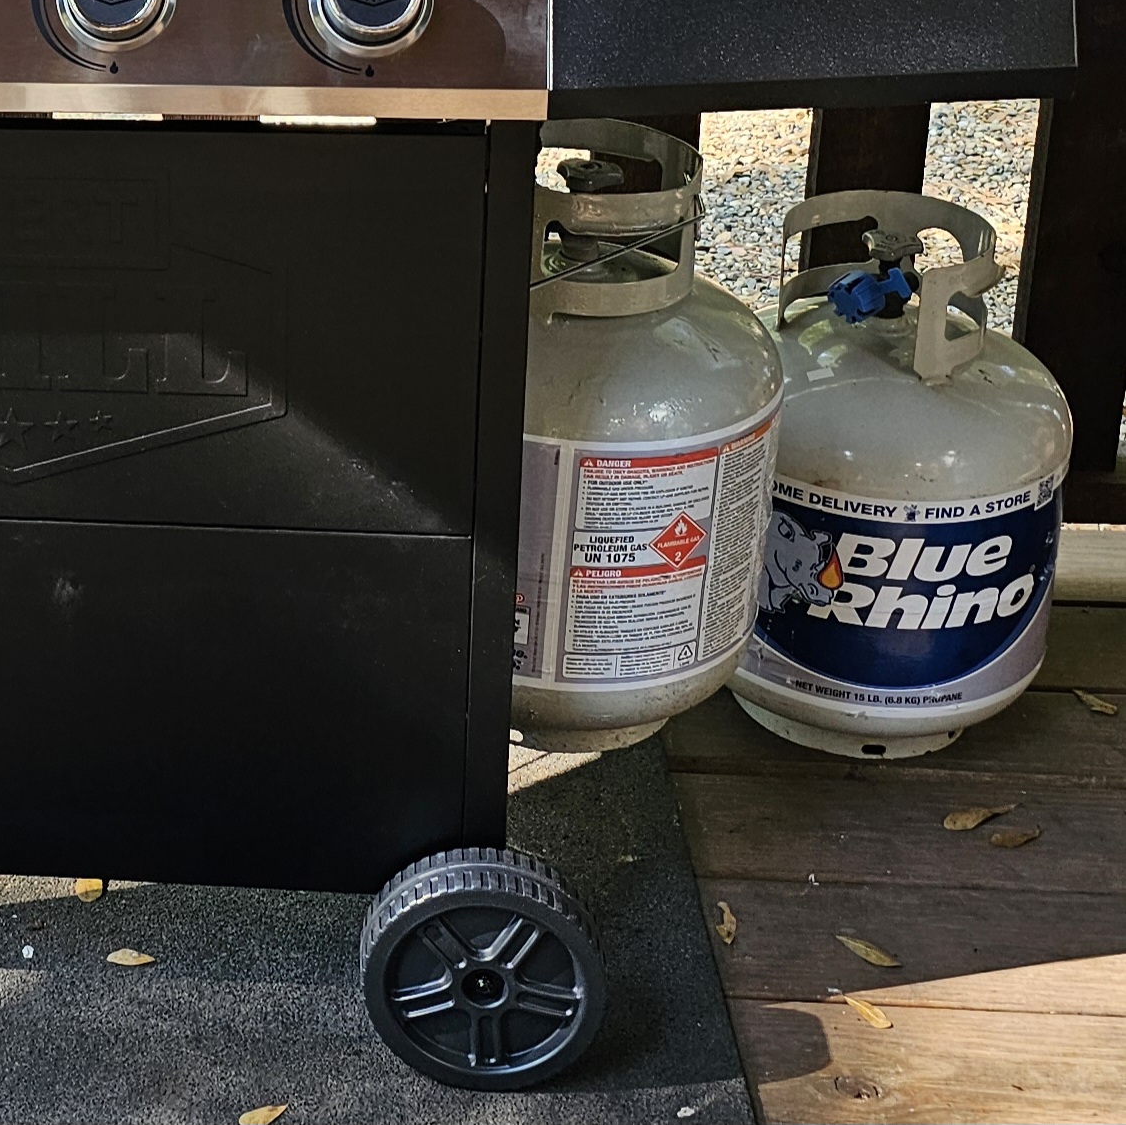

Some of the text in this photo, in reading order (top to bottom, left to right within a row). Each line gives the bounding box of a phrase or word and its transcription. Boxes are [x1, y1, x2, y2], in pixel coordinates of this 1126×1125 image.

[596, 459, 632, 467] DANGER
[809, 492, 897, 518] DELIVERY
[925, 490, 1031, 519] FIND A STORE
[589, 535, 634, 543] LIQUEFIED
[573, 543, 648, 552] PETROLEUM GAS
[584, 553, 636, 563] UN 1075
[674, 551, 681, 562] 2
[835, 532, 1013, 582] Blue
[585, 569, 622, 577] PELIGRO
[806, 573, 1035, 630] Rhino
[795, 679, 813, 691] NET
[815, 684, 851, 699] WEIGHT
[854, 693, 864, 701] 15
[867, 694, 882, 703] LB.
[885, 696, 903, 705] (6.8
[905, 695, 920, 705] KG)
